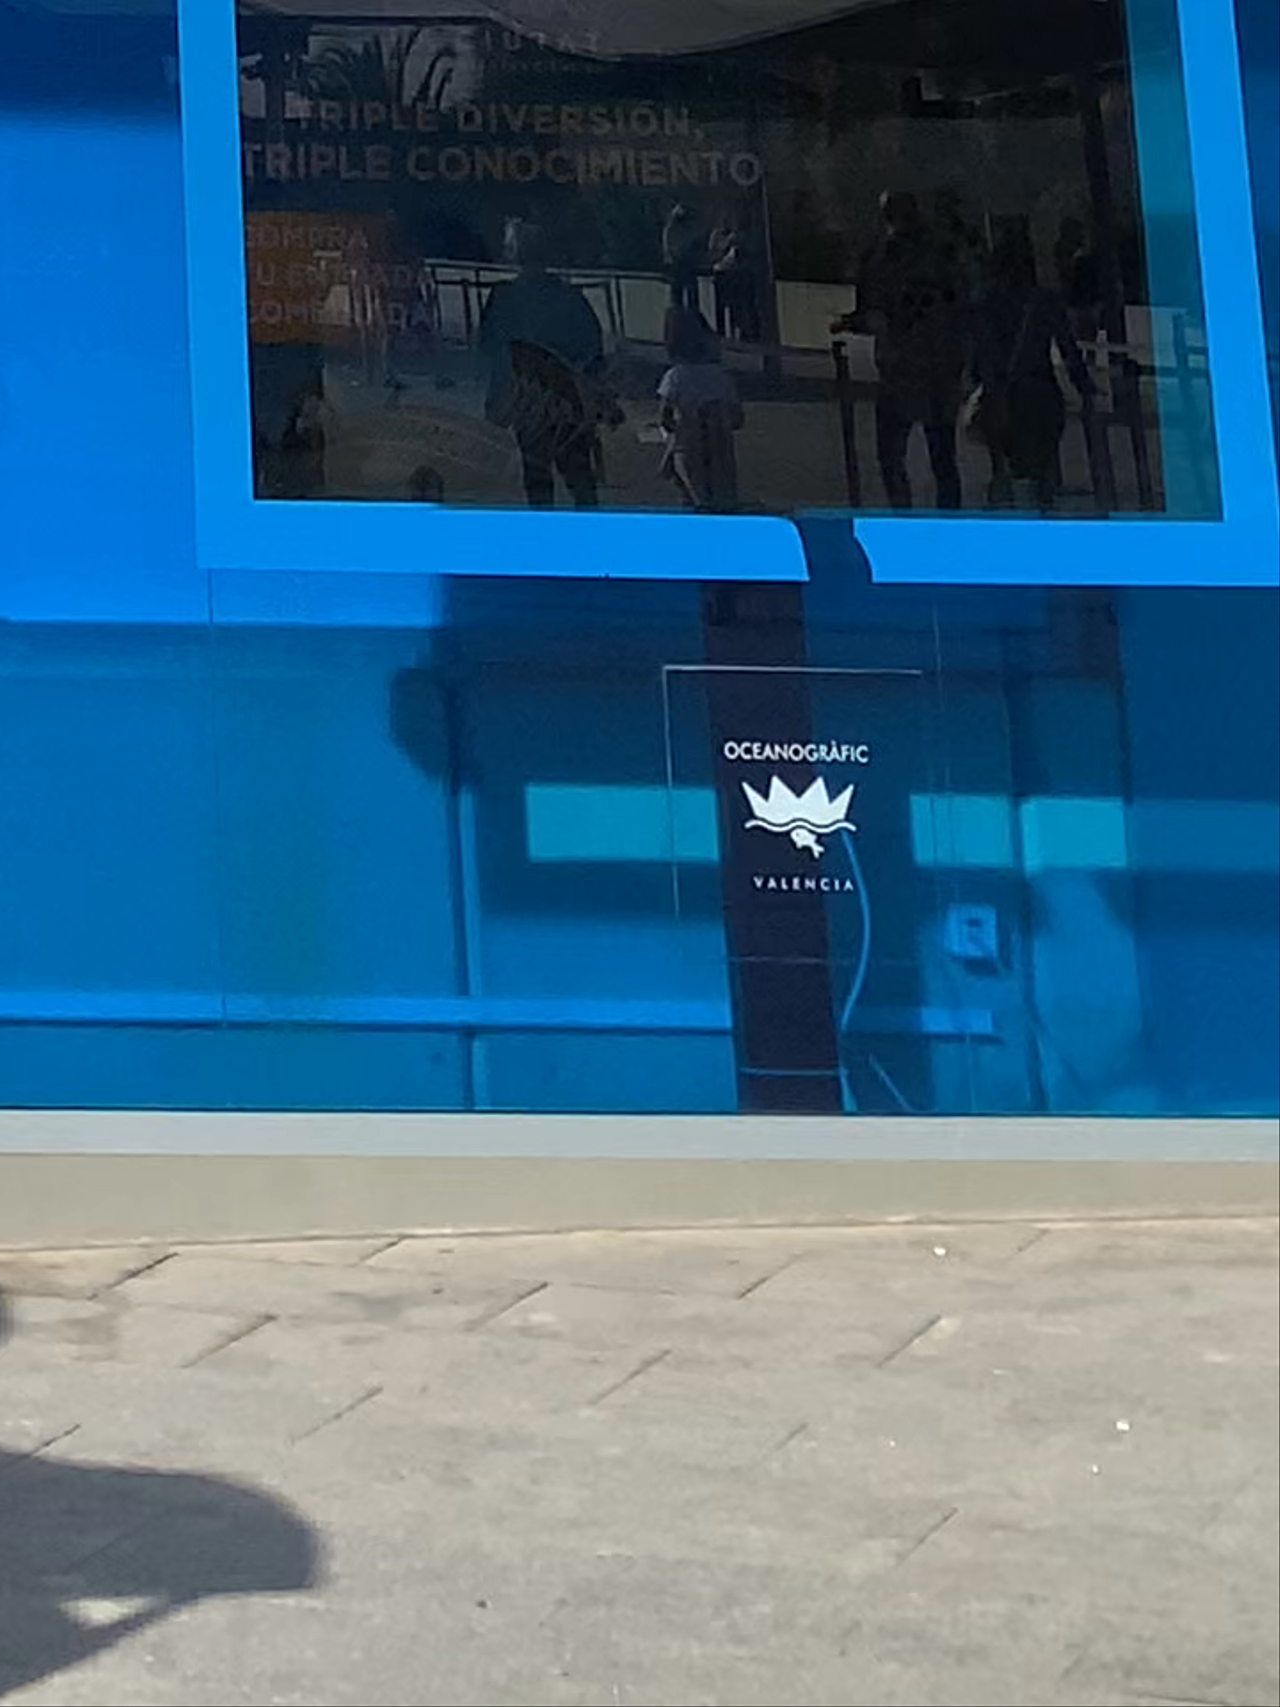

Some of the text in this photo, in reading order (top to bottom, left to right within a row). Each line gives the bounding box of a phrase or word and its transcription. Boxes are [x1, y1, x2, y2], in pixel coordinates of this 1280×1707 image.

[243, 143, 764, 186] TRIPLE CONOCIMIENTO
[723, 740, 870, 764] OCEANOGRÀFIC
[753, 876, 854, 892] VALENCIA
